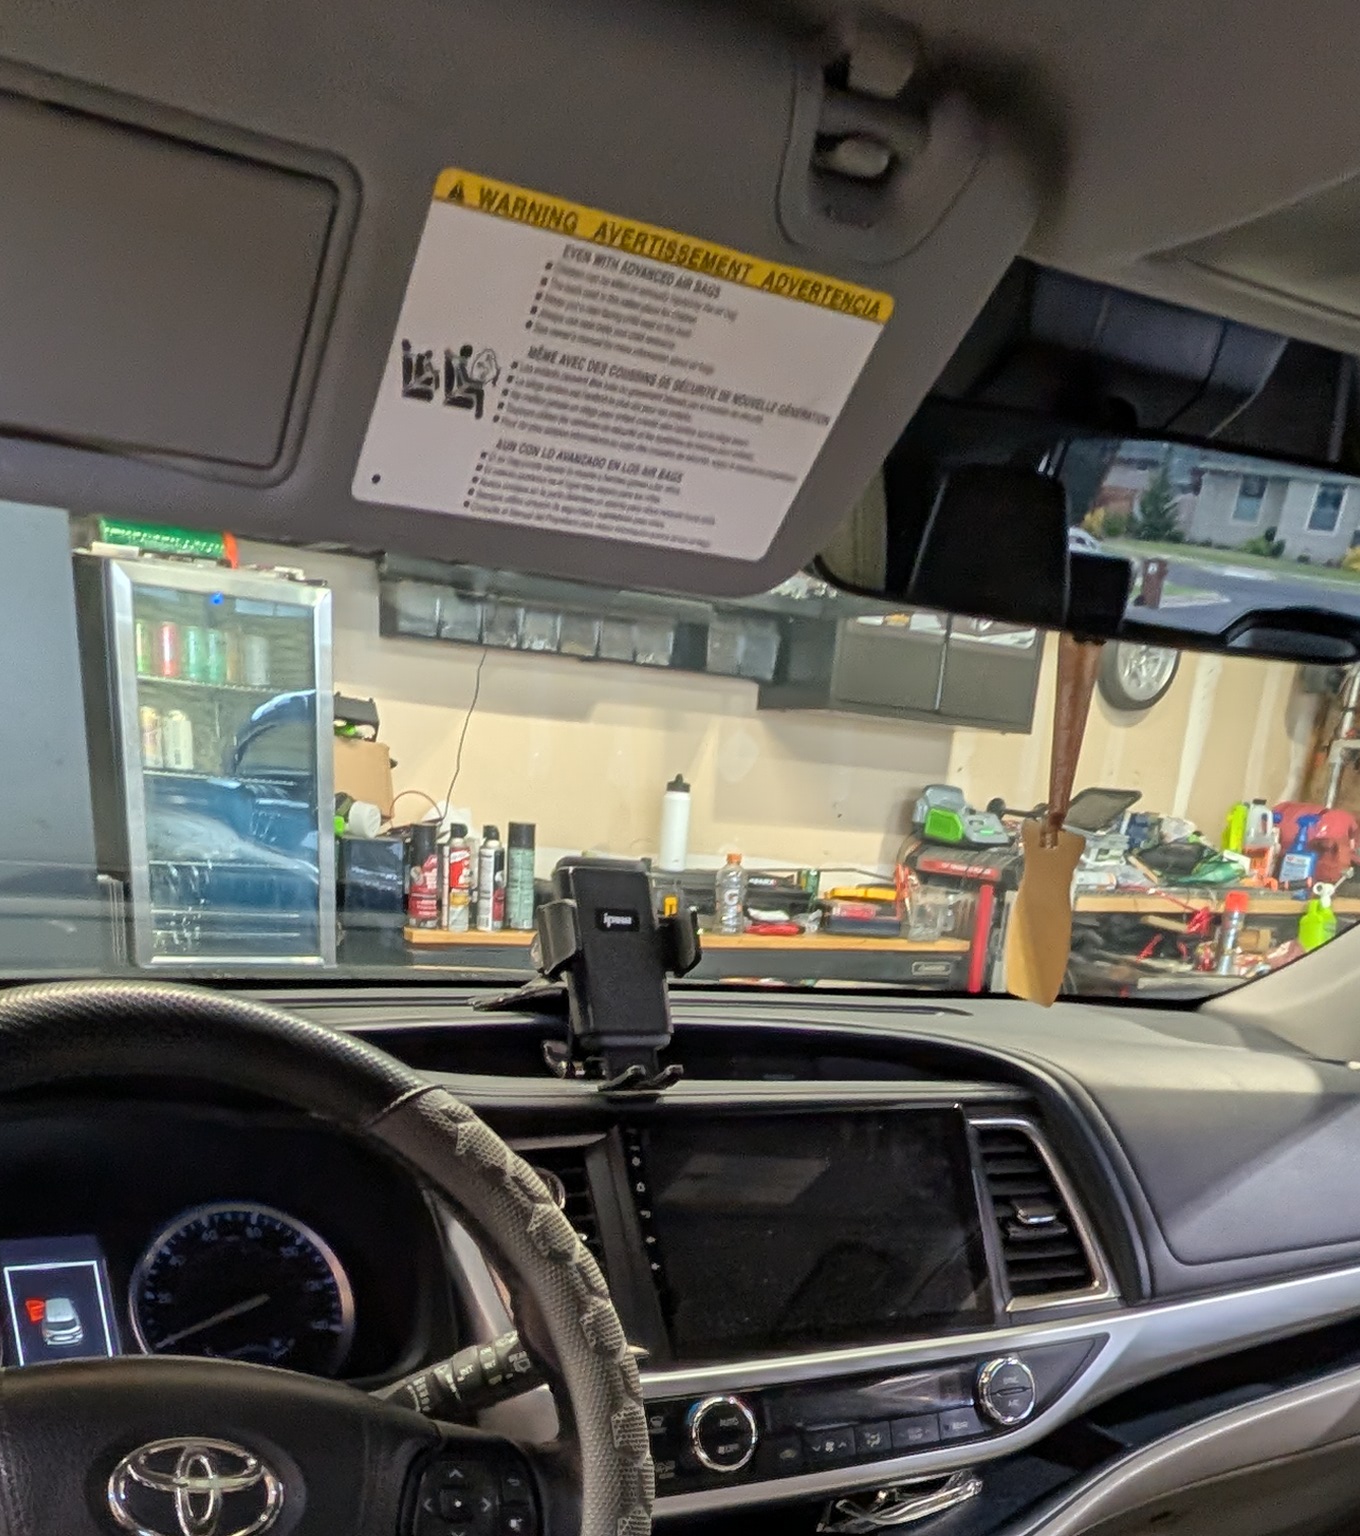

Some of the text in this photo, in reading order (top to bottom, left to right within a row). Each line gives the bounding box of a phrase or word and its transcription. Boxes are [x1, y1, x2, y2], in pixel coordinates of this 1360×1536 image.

[478, 185, 579, 234] WARNING
[593, 219, 753, 284] AVERTISSEMENT
[761, 269, 884, 319] ADVERTENCIA
